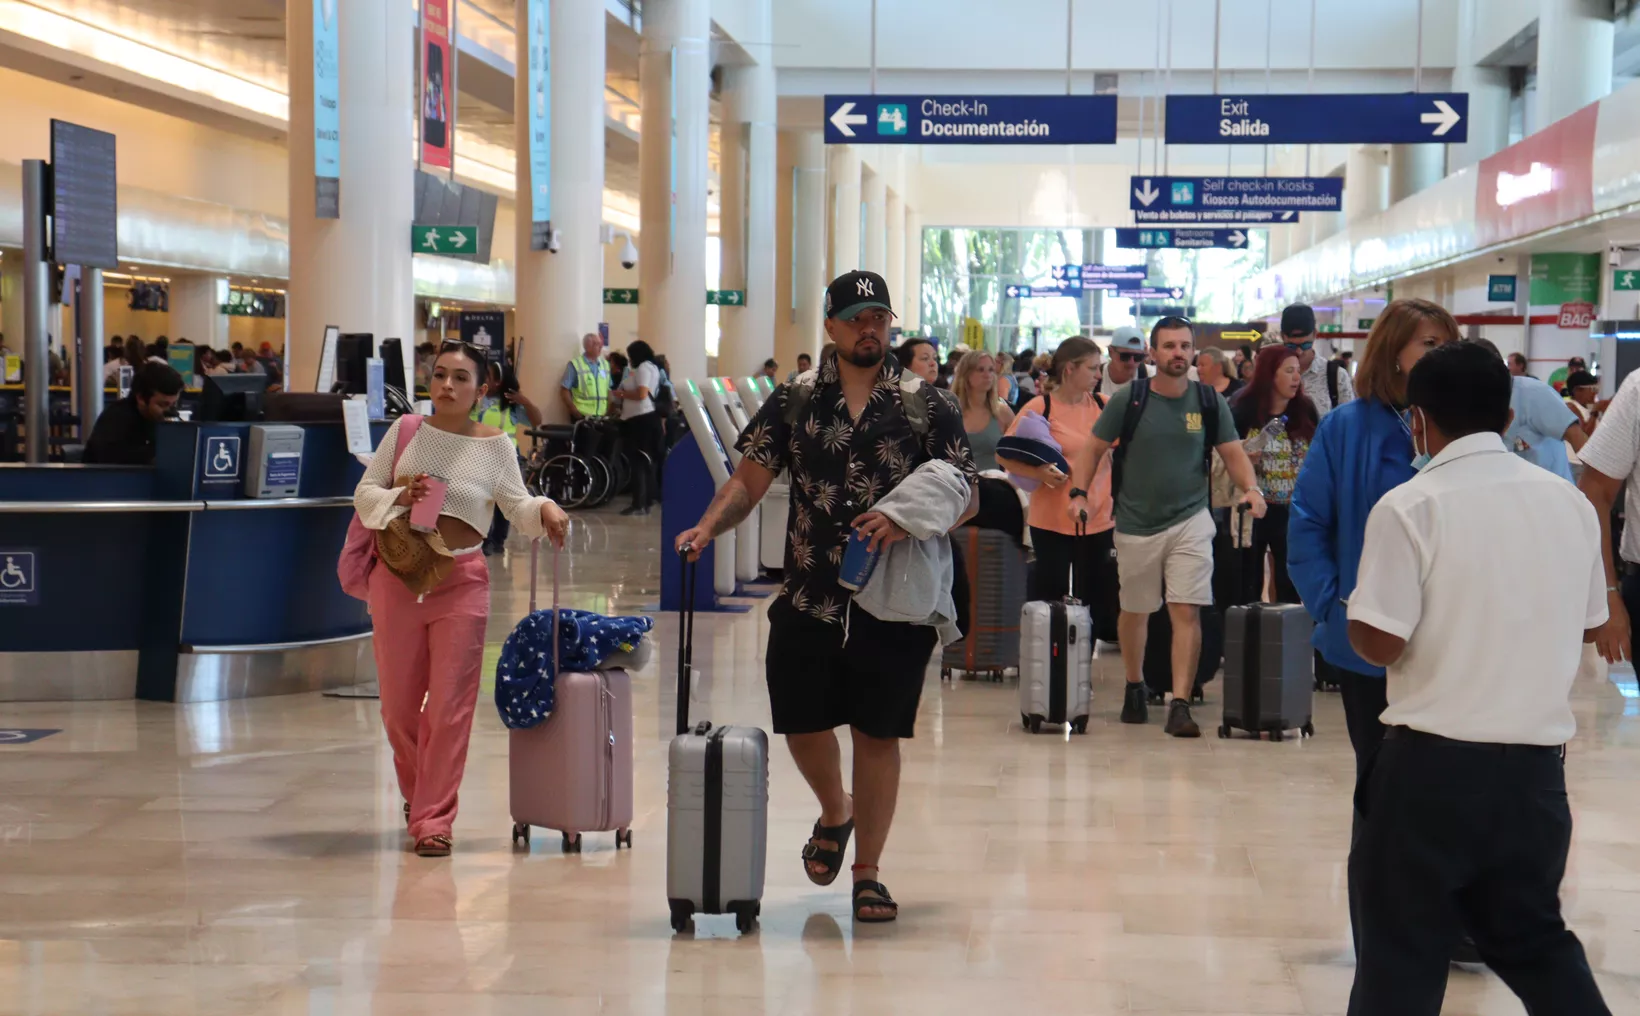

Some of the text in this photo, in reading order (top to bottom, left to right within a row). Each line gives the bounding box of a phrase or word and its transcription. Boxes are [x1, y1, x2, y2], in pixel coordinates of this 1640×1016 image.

[921, 99, 988, 116] Check-In
[1221, 98, 1249, 116] Exit
[920, 118, 1050, 137] Documentación
[1219, 118, 1270, 137] Salida
[1203, 178, 1314, 192] Self check-in Kiosks
[1202, 192, 1337, 206] Kioscos Autodocumentación
[1159, 210, 1169, 220] de
[1169, 210, 1196, 220] boletos
[1197, 213, 1202, 222] y
[1203, 211, 1233, 220] servicios
[1175, 229, 1214, 238] Restrooms
[1175, 238, 1214, 247] Sanitarios
[855, 277, 875, 297] NY
[1492, 283, 1512, 293] ATM
[1560, 313, 1590, 326] BAG
[1262, 459, 1291, 472] NICE
